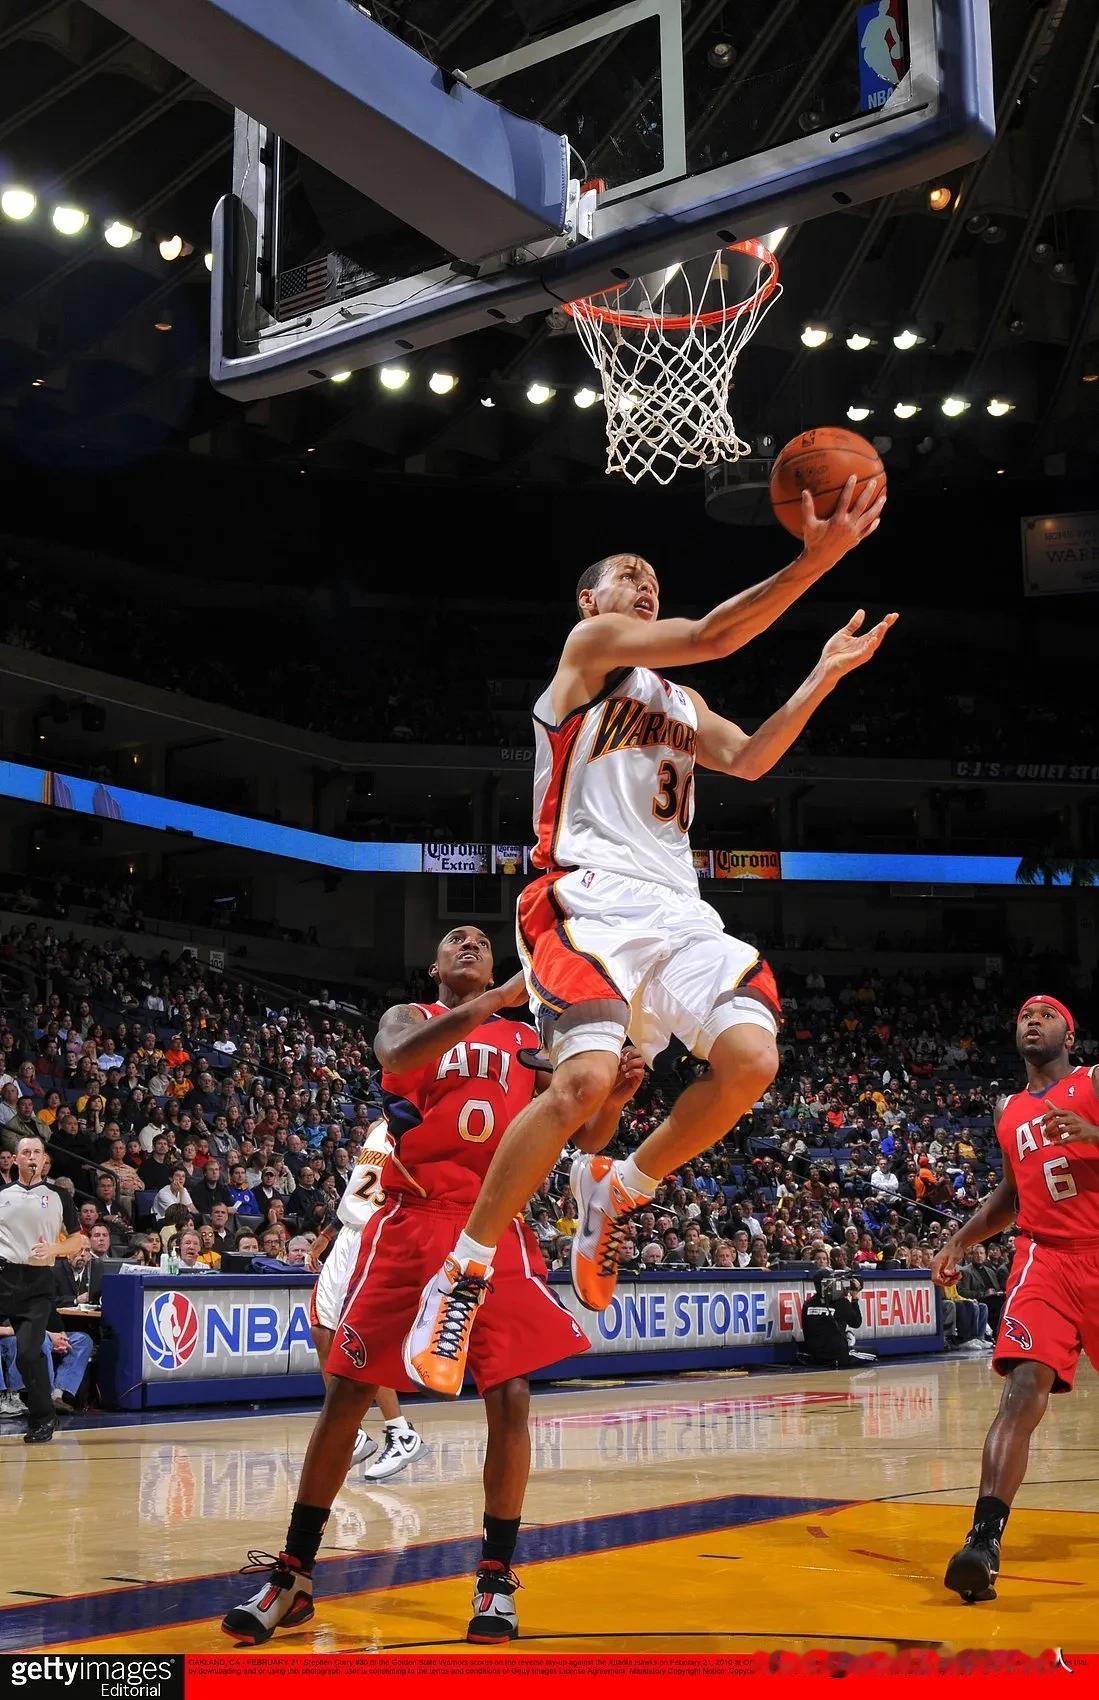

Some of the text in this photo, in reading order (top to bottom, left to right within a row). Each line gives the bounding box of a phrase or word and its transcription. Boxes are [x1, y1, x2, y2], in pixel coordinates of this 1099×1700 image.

[441, 858, 475, 870] Extra
[458, 1099, 495, 1143] 0
[1015, 1113, 1070, 1161] AT
[1043, 1156, 1078, 1202] 6
[203, 1303, 318, 1358] NBA
[597, 1290, 667, 1341] ONE
[673, 1290, 774, 1340] STORE,
[860, 1287, 932, 1329] TEAM!
